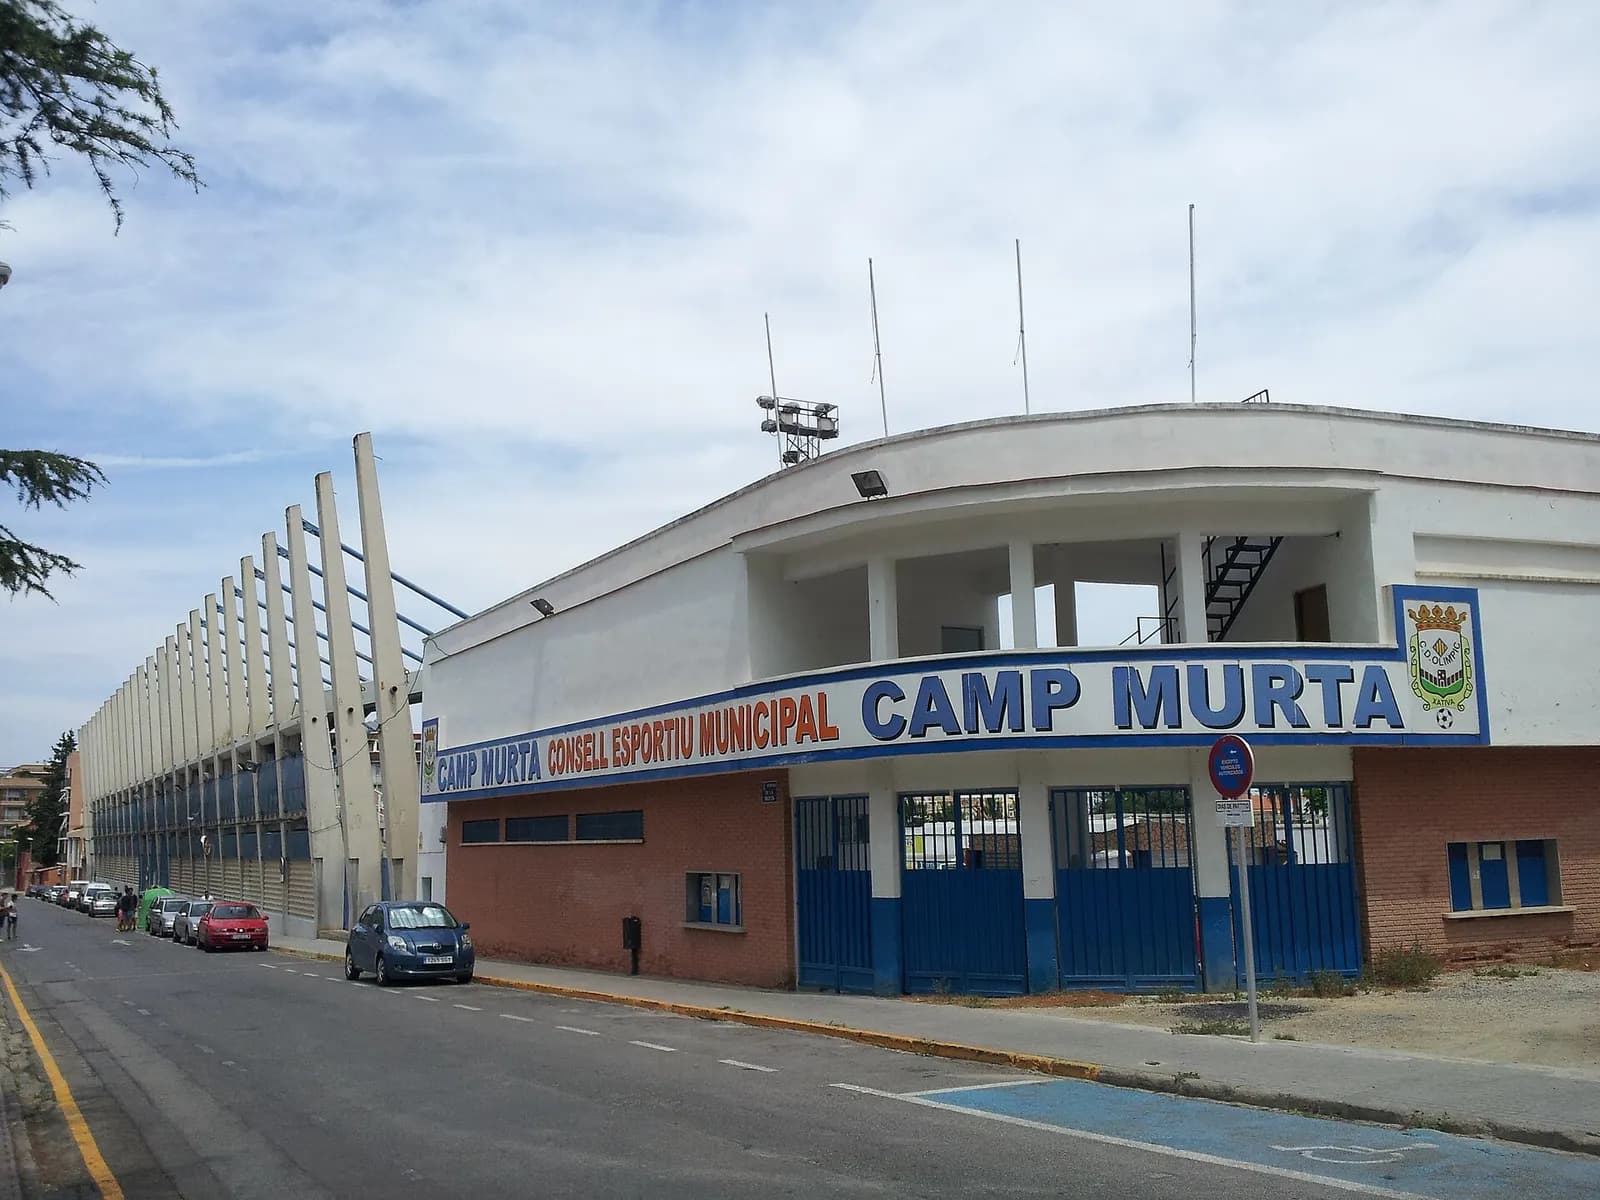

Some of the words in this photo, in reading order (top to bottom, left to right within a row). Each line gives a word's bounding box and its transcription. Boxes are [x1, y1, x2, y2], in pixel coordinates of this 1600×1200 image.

[547, 732, 608, 776] CONSELL
[612, 716, 693, 766] ESPORTIU
[699, 692, 839, 754] MUNICIPAL
[861, 671, 1080, 741] CAMP
[1113, 665, 1405, 731] MURTA
[438, 753, 477, 791] CAMP
[481, 740, 542, 786] MURTA
